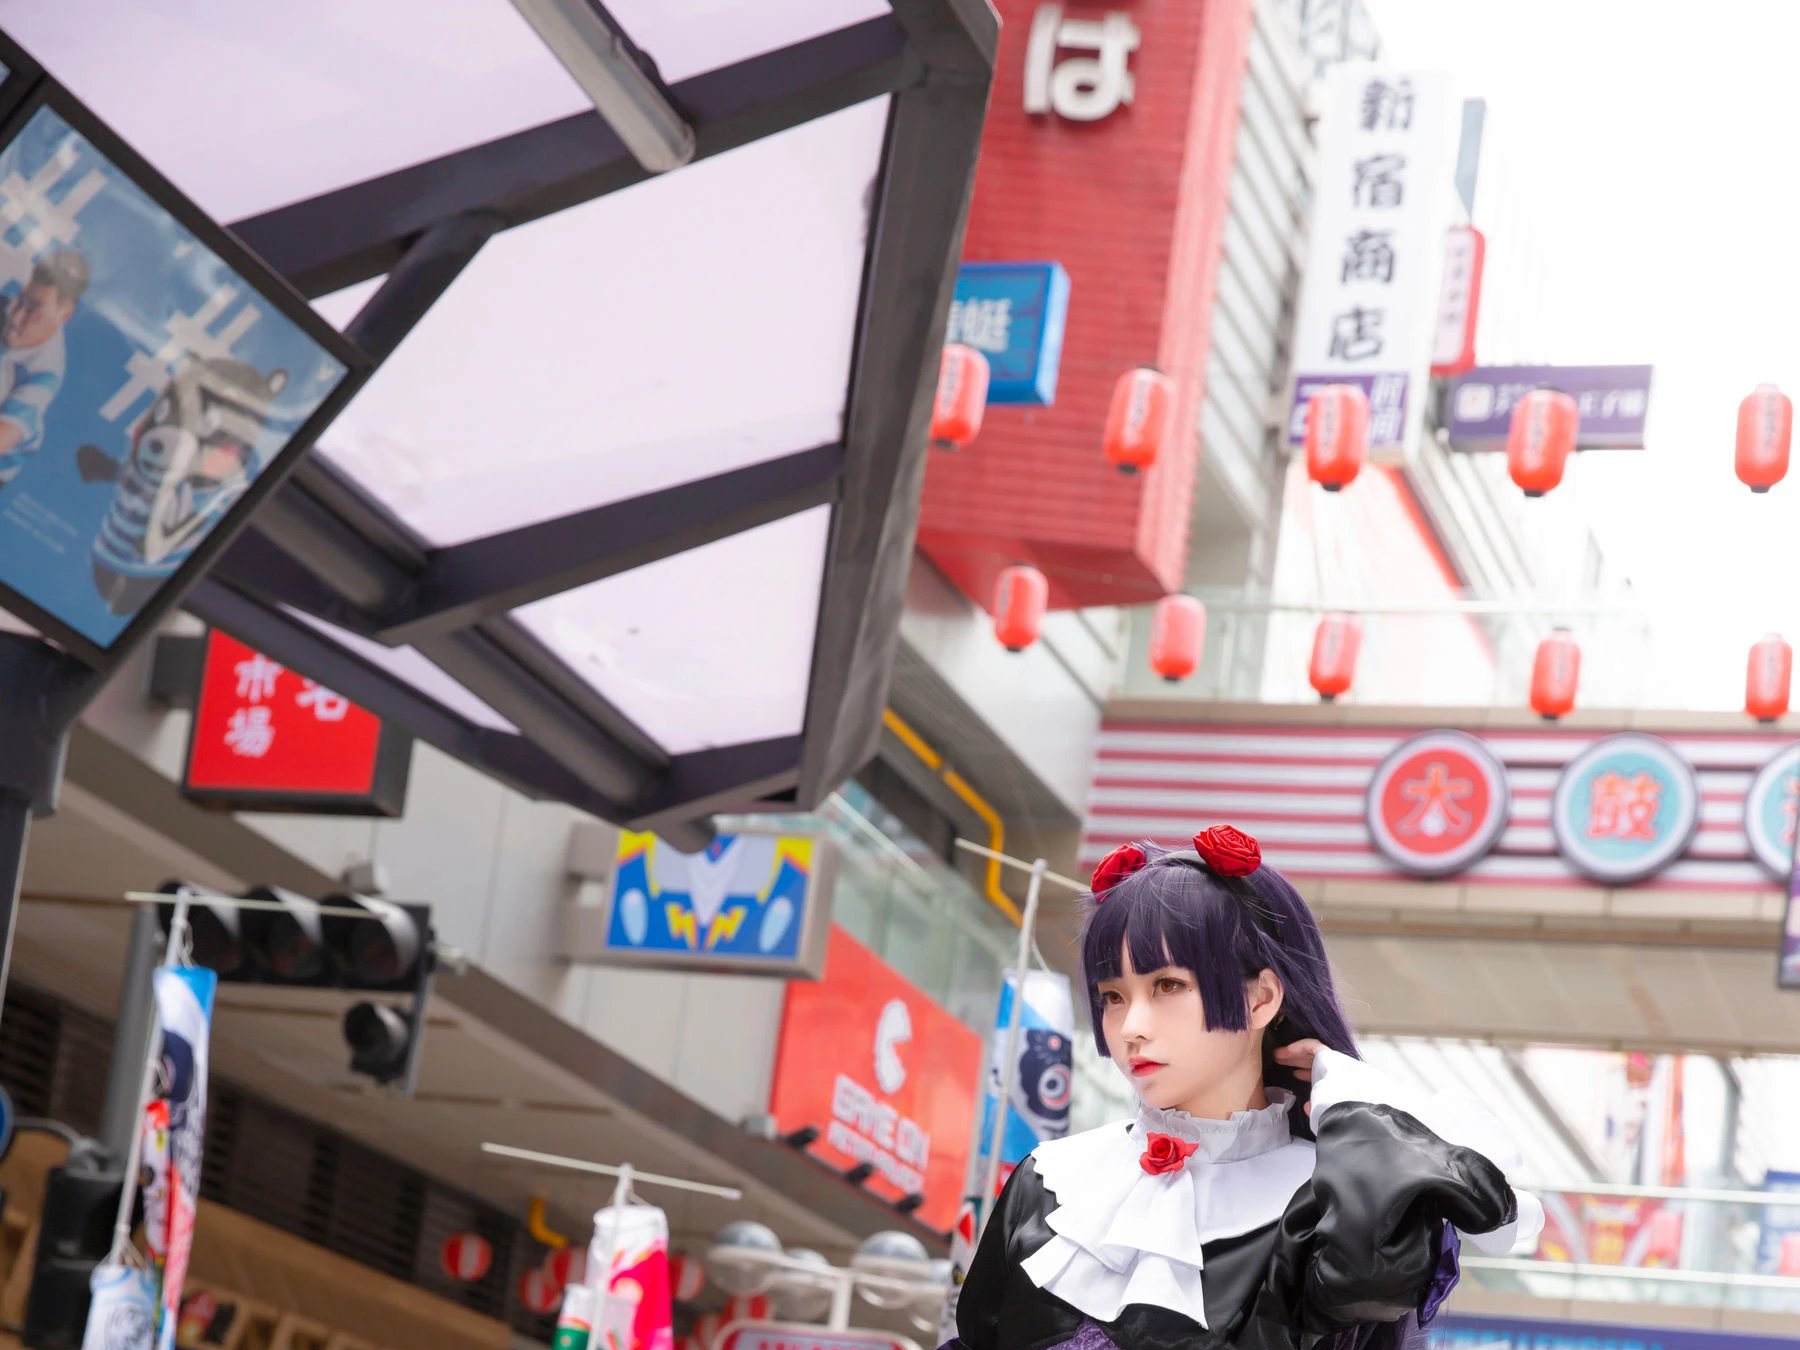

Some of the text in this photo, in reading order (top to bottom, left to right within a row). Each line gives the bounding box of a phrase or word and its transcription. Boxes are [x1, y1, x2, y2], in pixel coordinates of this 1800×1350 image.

[1023, 1, 1141, 121] は
[1327, 78, 1414, 361] 新宿商店
